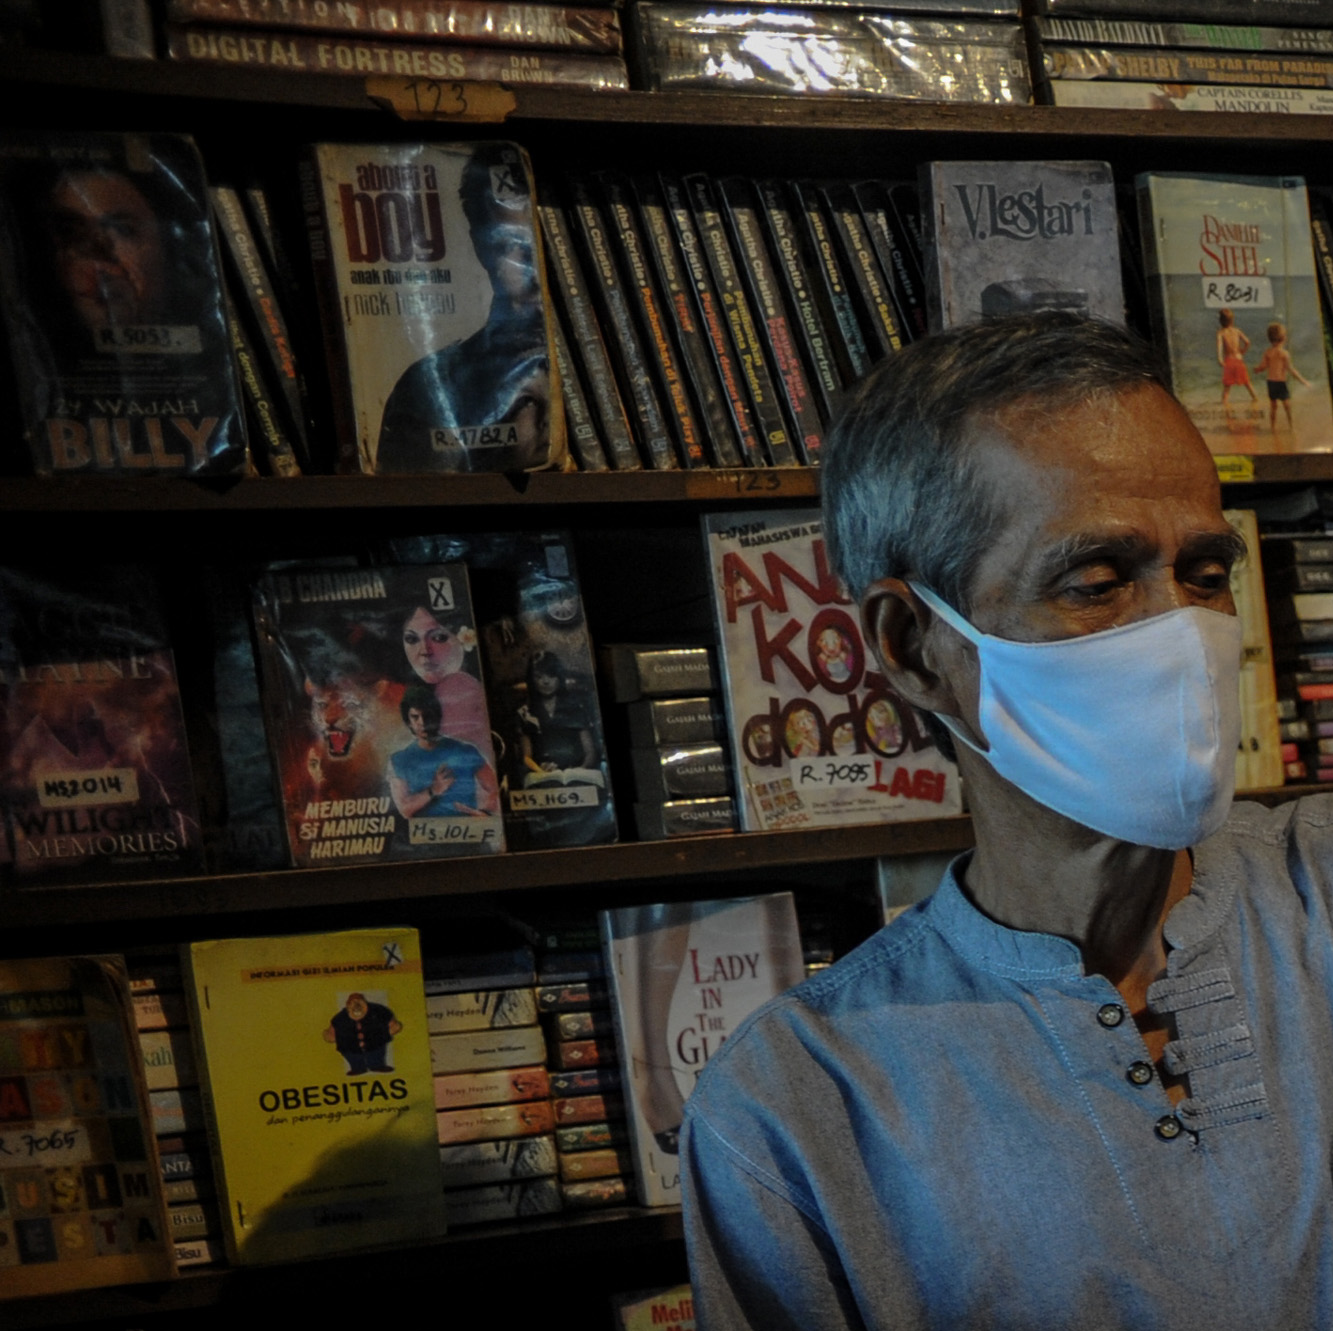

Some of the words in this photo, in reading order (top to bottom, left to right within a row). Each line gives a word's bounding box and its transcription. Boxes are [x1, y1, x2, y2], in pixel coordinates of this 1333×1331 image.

[186, 32, 306, 68] DIGITAL
[317, 44, 466, 77] FORTRESS
[509, 55, 541, 69] DAN
[1116, 56, 1181, 80] SHELBY
[1213, 99, 1290, 113] MANDOLIN
[337, 182, 447, 265] boy
[1201, 213, 1262, 246] DANIELLE
[738, 212, 758, 259] Agatha
[751, 260, 774, 309] Christie
[781, 237, 803, 289] Christie
[857, 250, 881, 299] Christie
[1199, 239, 1267, 277] STEEL
[801, 300, 819, 337] Hotel
[811, 336, 836, 393] Bertram
[96, 399, 199, 416] WAJAH
[46, 416, 221, 470] BILLY
[299, 574, 388, 603] CHANDRA
[428, 581, 450, 608] X
[866, 759, 947, 804] LAGI
[304, 797, 392, 820] MEMBURU
[321, 815, 396, 837] MANUSIA
[25, 831, 179, 860] MEMORIES
[309, 836, 385, 860] HARIMAU
[689, 948, 760, 986] LADY
[701, 987, 723, 1010] IN
[258, 1078, 409, 1114] OBESITAS
